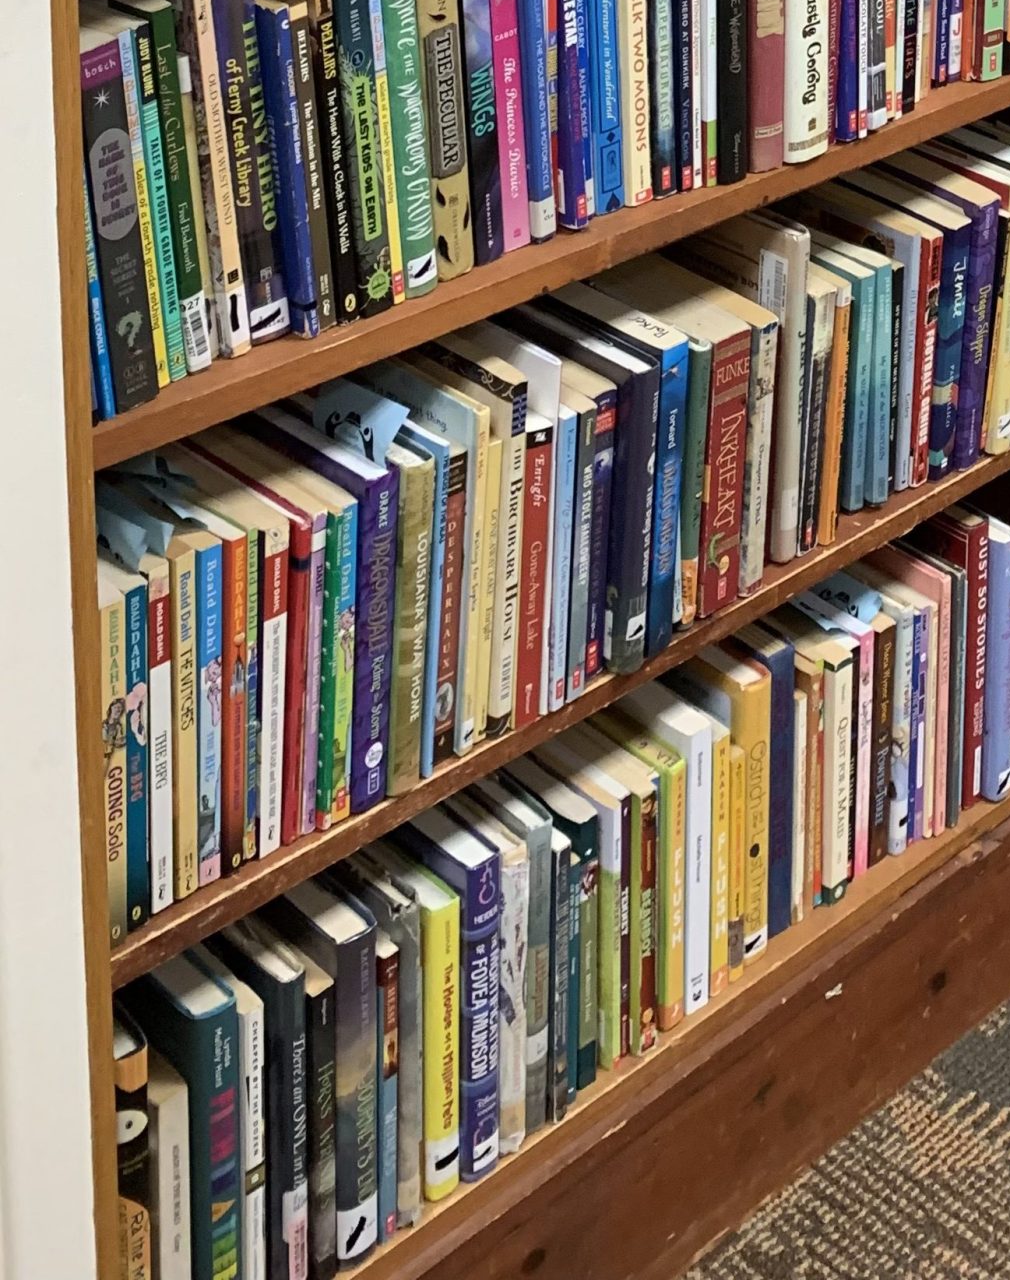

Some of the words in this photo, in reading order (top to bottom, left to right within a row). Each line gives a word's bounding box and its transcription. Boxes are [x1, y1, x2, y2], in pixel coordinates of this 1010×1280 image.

[225, 58, 241, 72] of
[296, 29, 309, 82] BELLAIRS
[436, 32, 453, 74] THE
[633, 27, 645, 73] TWO
[503, 57, 516, 83] The
[226, 76, 246, 114] Ferny
[303, 99, 313, 118] The
[439, 78, 459, 168] PECULIAR
[504, 88, 519, 145] Princess
[634, 80, 647, 152] MOONS
[150, 137, 162, 167] TALES
[231, 119, 250, 157] Creek
[306, 120, 317, 160] Mansion
[153, 170, 164, 181] OF
[234, 159, 253, 207] Library
[309, 162, 317, 171] in
[310, 173, 318, 186] the
[507, 148, 521, 198] Diaries
[156, 195, 169, 233] FOURTH
[311, 188, 321, 209] Mist
[160, 236, 172, 269] GRADE
[164, 271, 177, 314] NOTHING
[953, 256, 966, 318] Jennie
[716, 357, 749, 386] FUNKE
[921, 328, 936, 394] FOOTBALL
[918, 398, 930, 445] GENIUS
[530, 454, 546, 508] Enright
[583, 464, 593, 488] WHO
[713, 408, 745, 529] INKHEART
[581, 491, 593, 521] STOLE
[978, 536, 988, 581] JUST
[180, 571, 190, 610] Roald
[205, 559, 217, 608] Roald
[414, 531, 428, 632] LOUISIANA'S
[526, 541, 543, 615] Gone-Away
[978, 587, 988, 610] SO
[156, 603, 164, 633] ROALD
[181, 613, 191, 642] Dahl
[206, 619, 218, 655] Dahl
[526, 618, 539, 650] Lake
[156, 635, 164, 661] DAHL
[413, 637, 424, 671] WAY
[976, 615, 987, 689] STORIES
[409, 675, 421, 723] HOME
[155, 731, 167, 761] THE
[107, 766, 123, 820] GOING
[155, 763, 168, 790] BFG
[107, 825, 123, 862] Solo
[444, 963, 453, 985] The
[470, 956, 488, 1011] FOVEA
[443, 985, 454, 1030] House
[471, 1010, 488, 1079] MUNSON
[253, 1076, 258, 1089] BY
[293, 1087, 303, 1104] an
[293, 1104, 306, 1154] OWL
